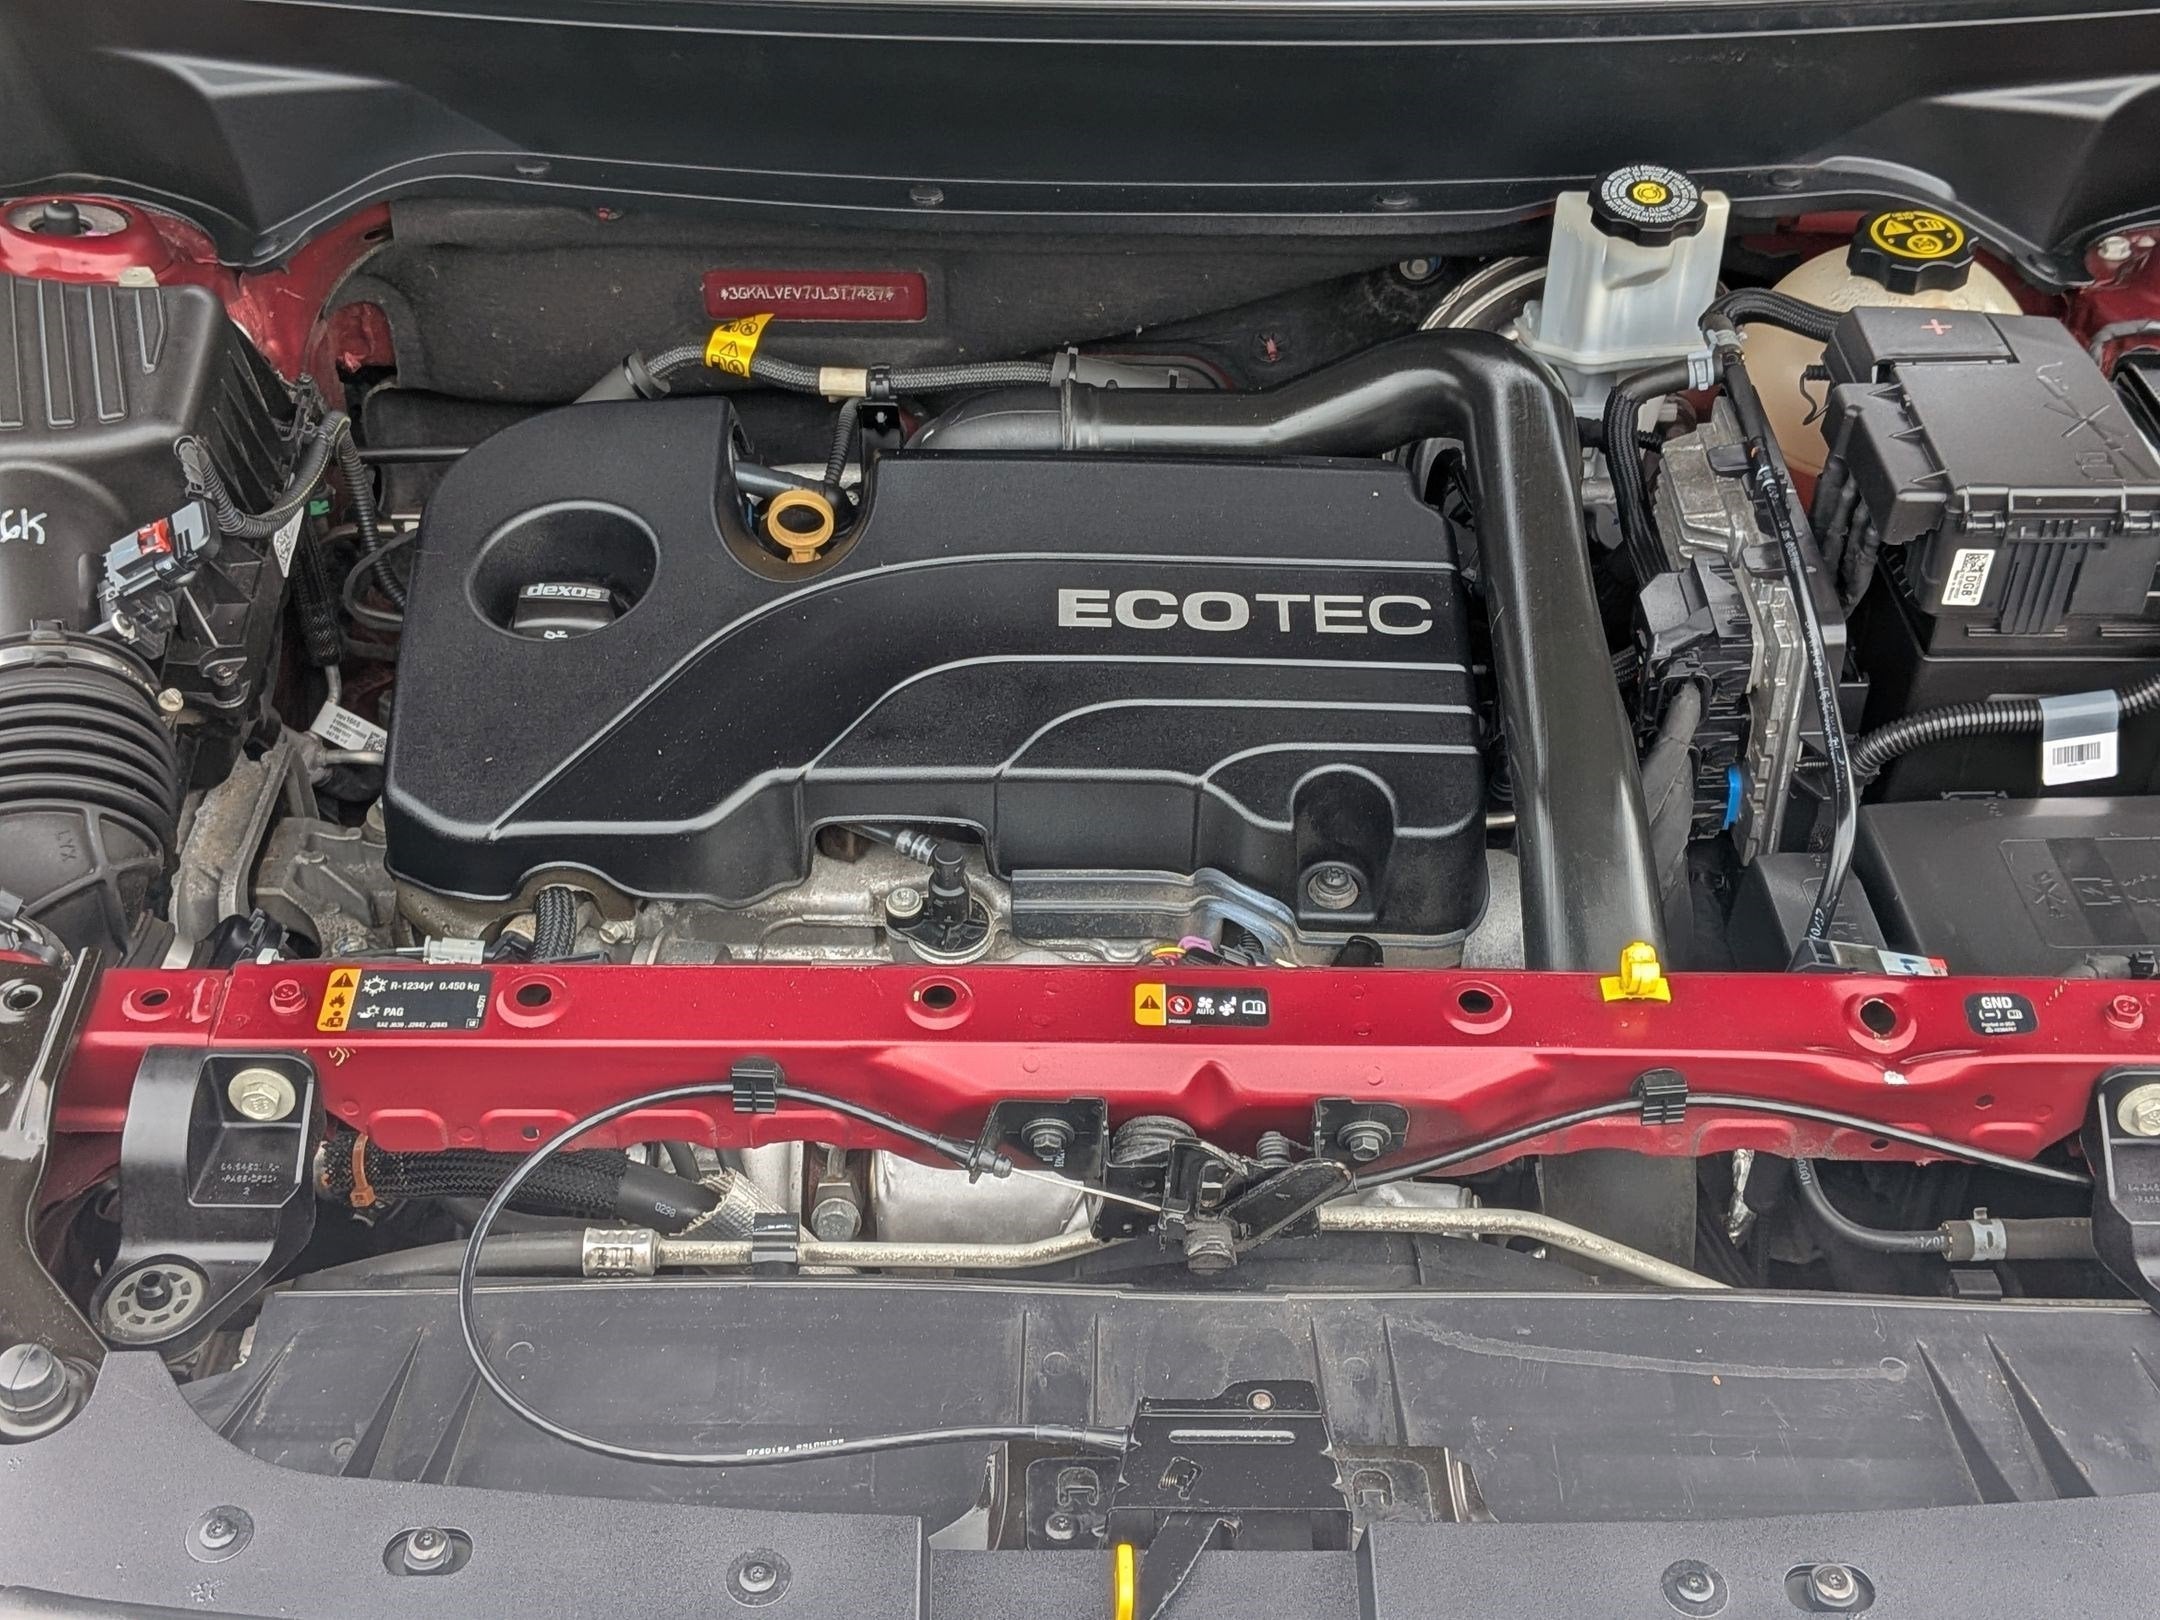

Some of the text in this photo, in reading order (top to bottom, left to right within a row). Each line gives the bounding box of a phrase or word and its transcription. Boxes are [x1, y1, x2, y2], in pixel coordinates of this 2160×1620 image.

[527, 583, 603, 599] dexos
[1058, 588, 1434, 635] ECOTEC
[439, 981, 465, 991] 0.450
[467, 981, 481, 992] kg
[1981, 996, 2013, 1009] GND
[383, 1006, 405, 1017] PAG
[1195, 1007, 1215, 1015] AUTO
